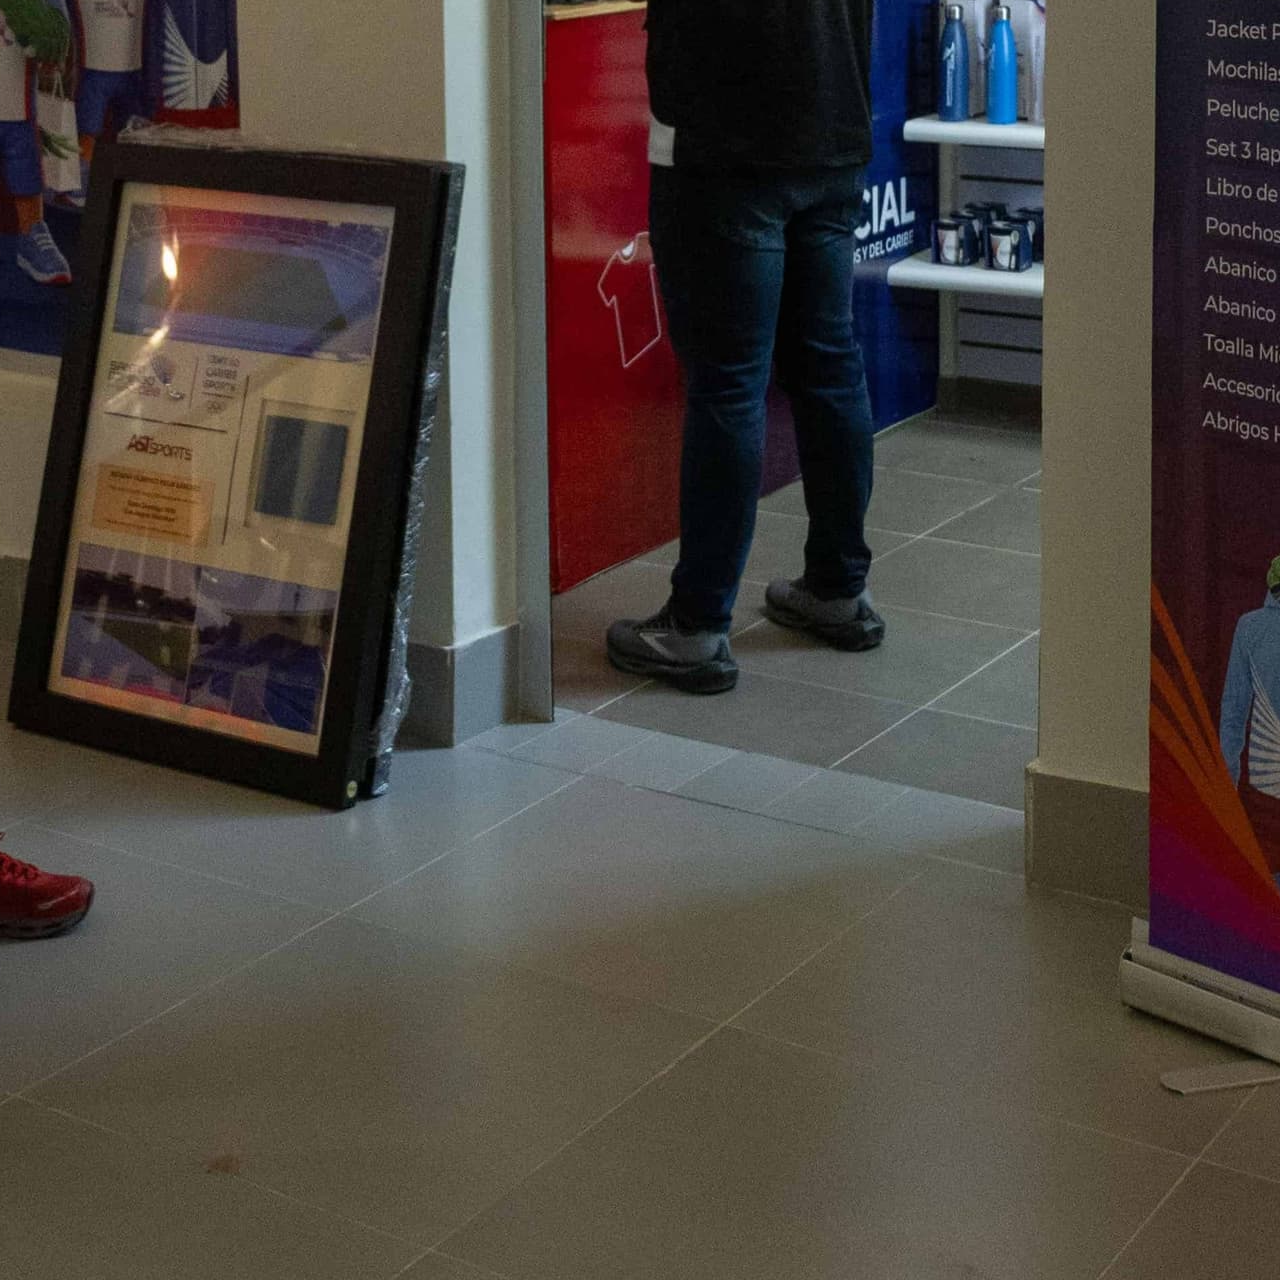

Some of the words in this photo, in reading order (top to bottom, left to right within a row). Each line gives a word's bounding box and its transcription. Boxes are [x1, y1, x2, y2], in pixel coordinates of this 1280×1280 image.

[1206, 20, 1267, 41] Jacket
[1206, 99, 1280, 119] Peluche
[1206, 139, 1237, 159] Set
[1241, 142, 1252, 159] 3
[1206, 177, 1252, 199] Libro
[1256, 183, 1278, 202] de
[869, 240, 885, 258] DEL
[886, 229, 914, 252] CARIBE
[1204, 256, 1277, 283] Abanico
[1203, 295, 1276, 322] Abanico
[1204, 333, 1254, 359] Toalla
[1202, 410, 1270, 440] Abrigos
